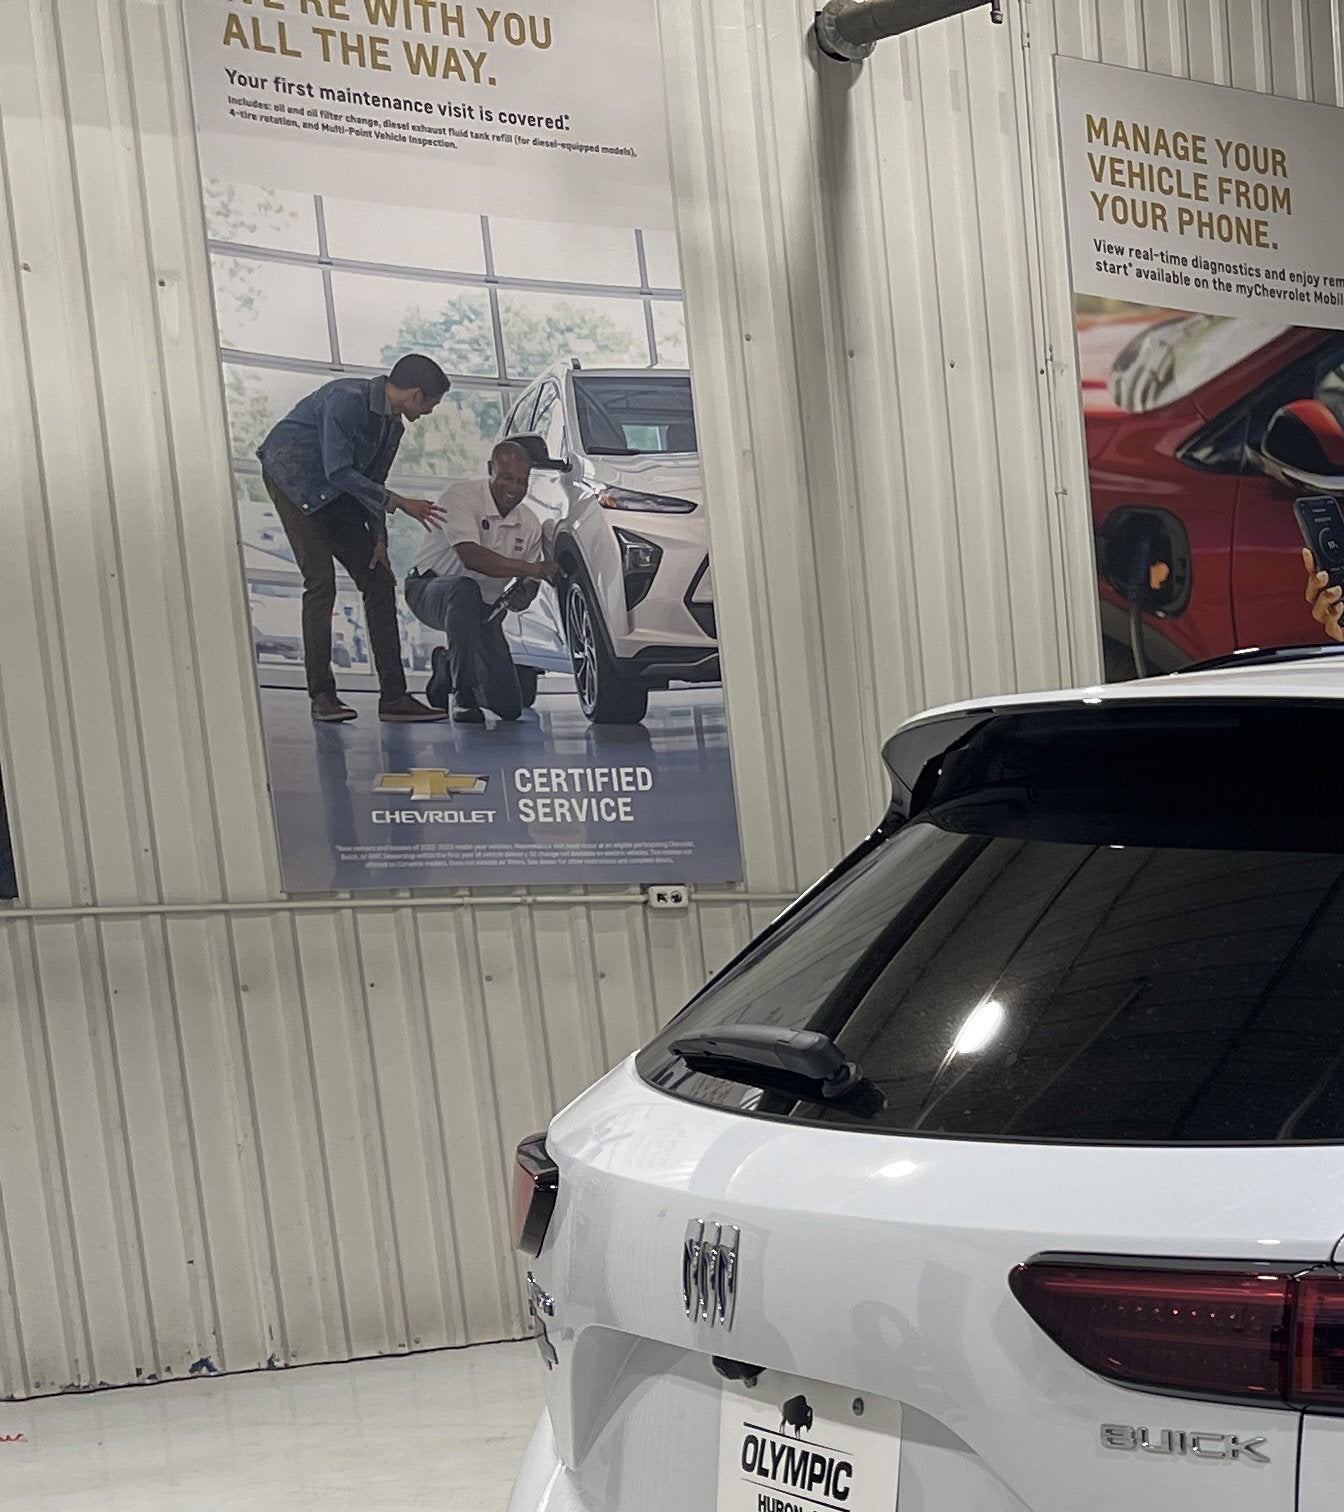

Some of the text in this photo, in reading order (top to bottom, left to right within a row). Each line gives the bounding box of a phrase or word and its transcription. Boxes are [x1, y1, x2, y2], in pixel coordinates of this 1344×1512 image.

[364, 0, 466, 38] WITH
[477, 8, 552, 49] YOU
[223, 13, 497, 86] ALL THE WAY.
[225, 67, 268, 90] Your
[274, 76, 315, 98] first
[320, 86, 433, 114] maintenance
[437, 101, 475, 120] visit
[479, 105, 493, 122] is
[227, 95, 272, 111] Includes:
[273, 104, 286, 113] oil
[287, 107, 305, 116] and
[306, 109, 319, 118] oil
[320, 110, 343, 121] filter
[345, 114, 382, 128] change,
[383, 119, 410, 130] diesel
[411, 124, 446, 135] exhaust
[448, 127, 469, 138] fluid
[470, 131, 490, 141] tank
[491, 134, 513, 143] refill
[514, 134, 531, 145] (for
[229, 108, 258, 121] 4-tire
[259, 114, 301, 128] rotation,
[302, 121, 320, 131] and
[321, 124, 373, 139] Multi-Point
[374, 130, 407, 143] Vehicle
[1086, 114, 1288, 178] MANAGE YOUR
[1087, 152, 1291, 215] VEHICLE FROM
[1090, 190, 1278, 250] YOUR PHONE.
[1093, 238, 1125, 256] View
[1129, 247, 1187, 267] real-time
[1191, 255, 1261, 278] diagnostics
[1265, 268, 1286, 281] and
[1289, 271, 1321, 287] enjoy
[1135, 267, 1190, 286] available
[1194, 277, 1209, 289] on
[1212, 278, 1232, 292] the
[1236, 283, 1311, 303] myChevrolet
[514, 767, 653, 793] CERTIFIED
[371, 810, 497, 824] CHEVROLET
[517, 797, 635, 823] SERVICE
[740, 1434, 853, 1502] OLYMPIC
[1100, 1423, 1271, 1464] BUICK
